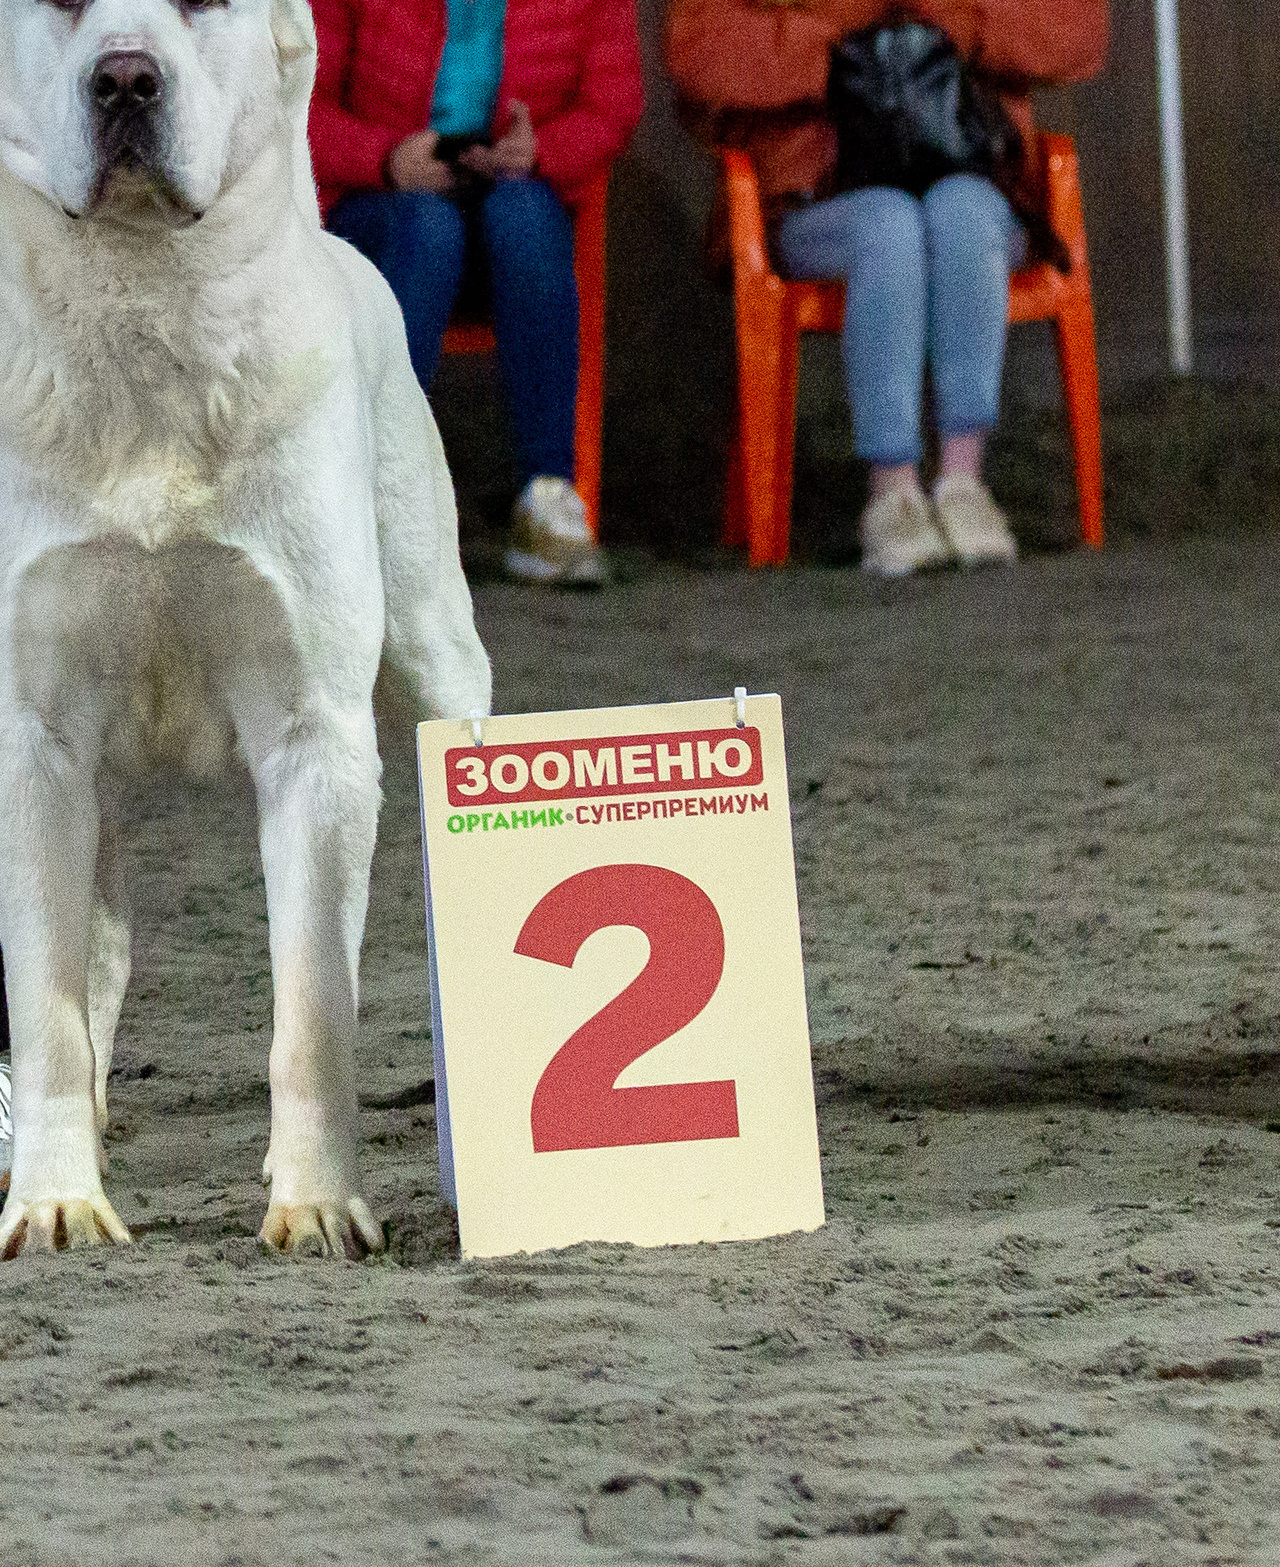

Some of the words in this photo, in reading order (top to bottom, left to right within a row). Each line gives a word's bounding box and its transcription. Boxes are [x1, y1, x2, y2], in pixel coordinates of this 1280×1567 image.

[455, 738, 753, 797] ЗООМЕНЮ
[446, 808, 565, 834] ОРГАНИК
[575, 793, 770, 825] СУПЕРПРЕМИУМ
[513, 863, 740, 1153] 2
